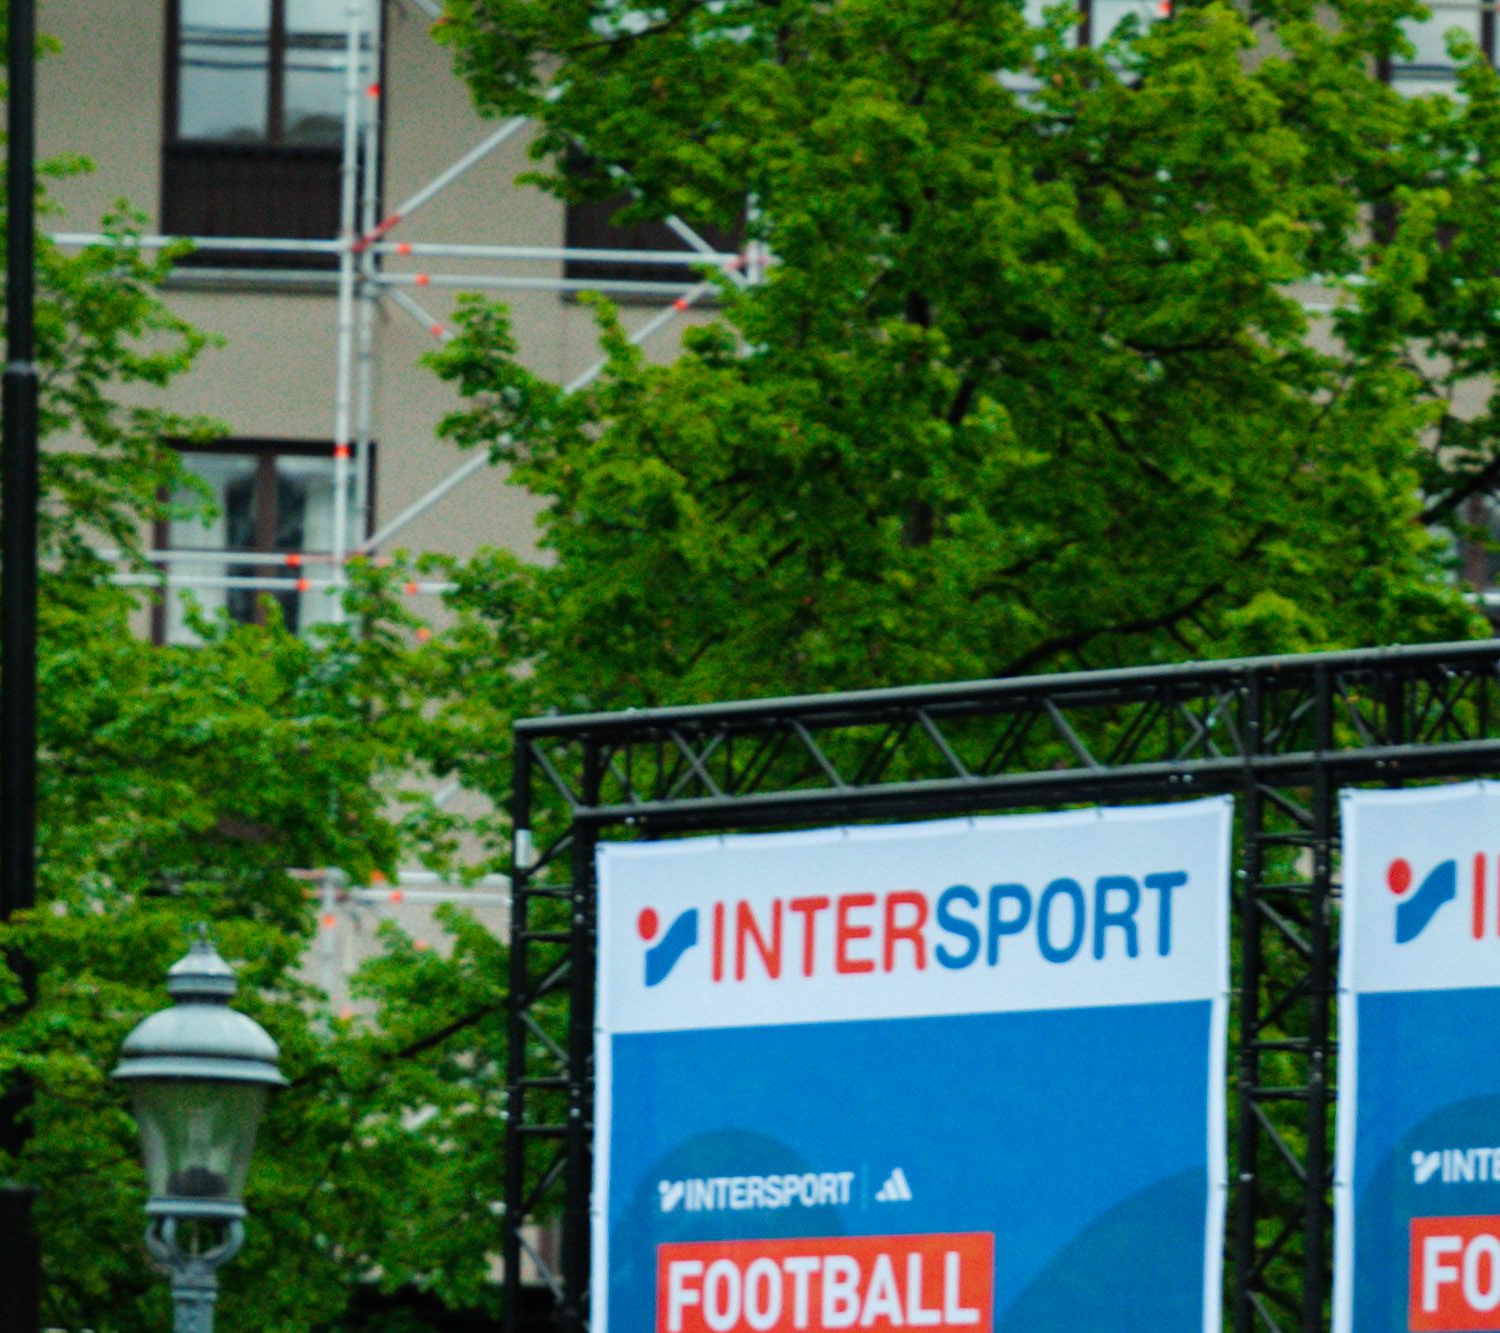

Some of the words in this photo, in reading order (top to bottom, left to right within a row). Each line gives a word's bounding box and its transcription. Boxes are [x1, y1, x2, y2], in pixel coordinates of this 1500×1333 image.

[711, 869, 1190, 982] INTERSPORT
[685, 1171, 854, 1211] INTERSPORT
[666, 1250, 981, 1333] FOOTBALL
